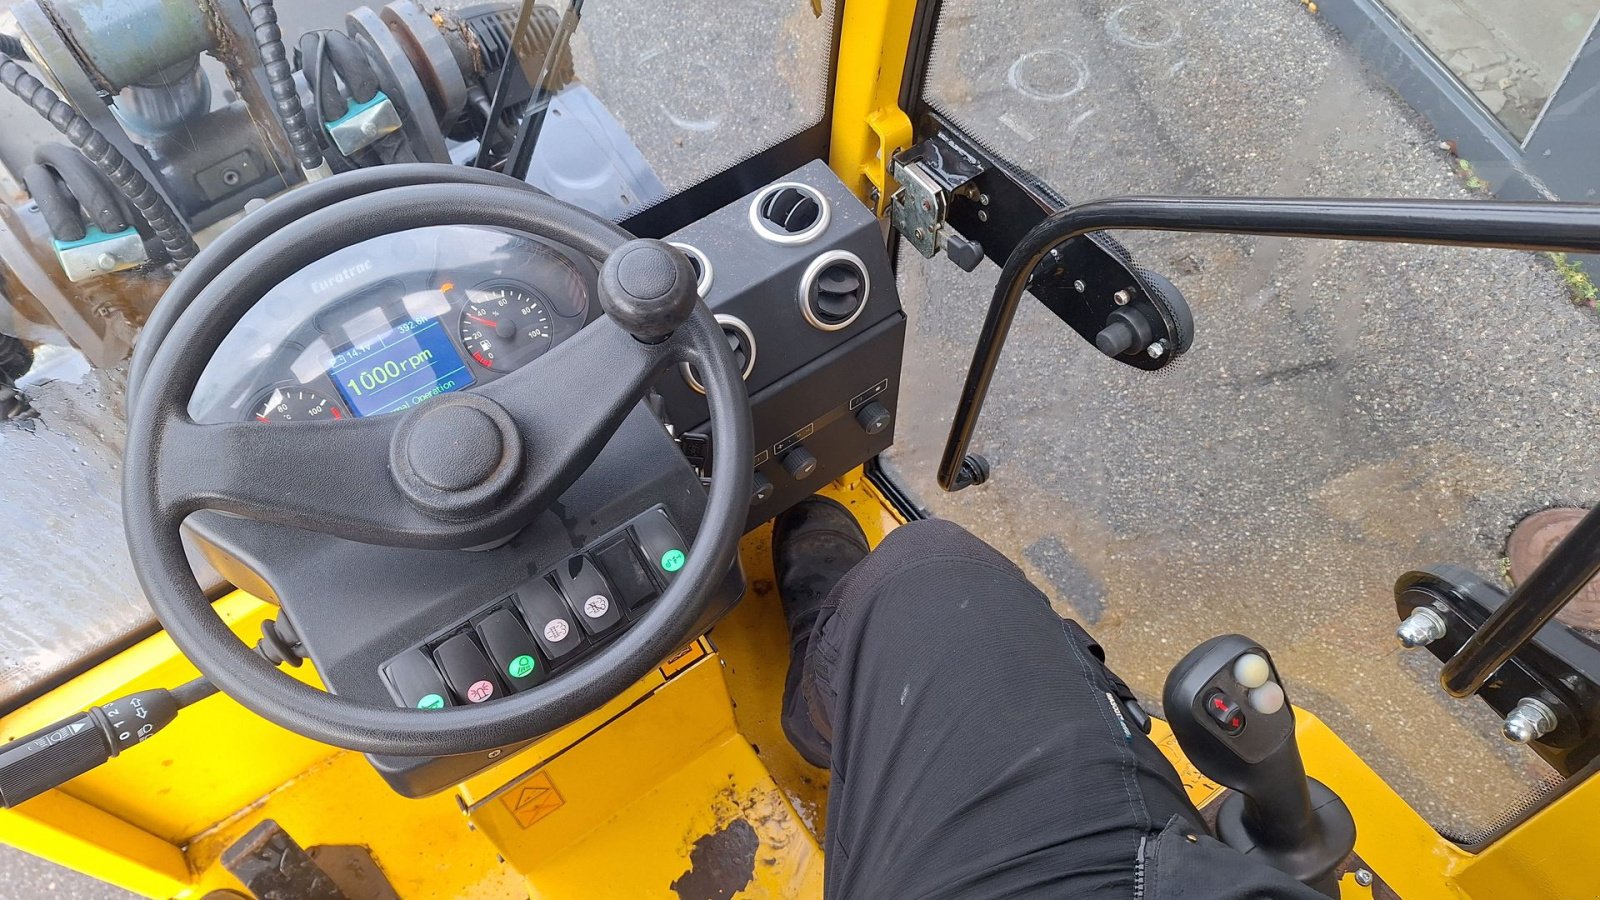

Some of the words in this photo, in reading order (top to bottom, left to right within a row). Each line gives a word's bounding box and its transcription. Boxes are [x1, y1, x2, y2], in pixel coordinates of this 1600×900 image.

[311, 259, 373, 294] Eurotrac
[498, 298, 508, 307] 60
[521, 306, 531, 315] 80
[472, 331, 482, 340] 20
[528, 328, 541, 338] 100
[308, 405, 323, 417] 100
[108, 708, 119, 717] 2
[113, 720, 125, 729] 1
